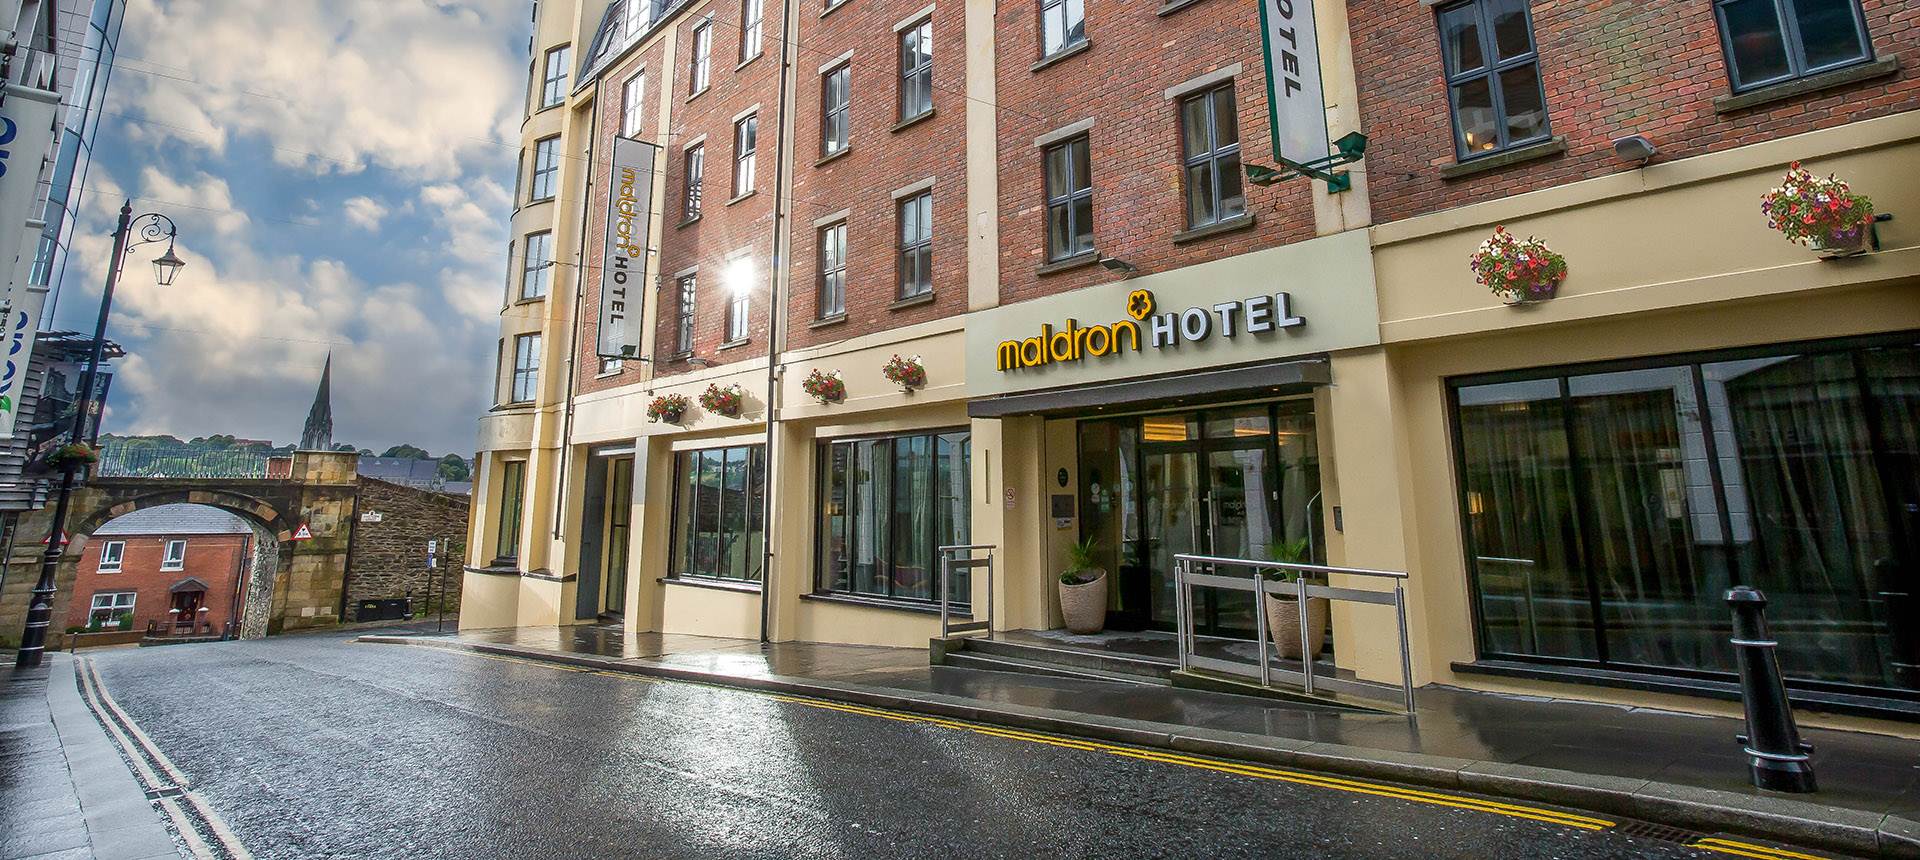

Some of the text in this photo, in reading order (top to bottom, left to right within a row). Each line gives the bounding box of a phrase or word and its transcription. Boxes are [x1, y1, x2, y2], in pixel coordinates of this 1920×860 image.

[1276, 0, 1302, 98] OTEL
[610, 167, 638, 325] maldron HOTEL
[997, 291, 1307, 372] maldron HOTEL
